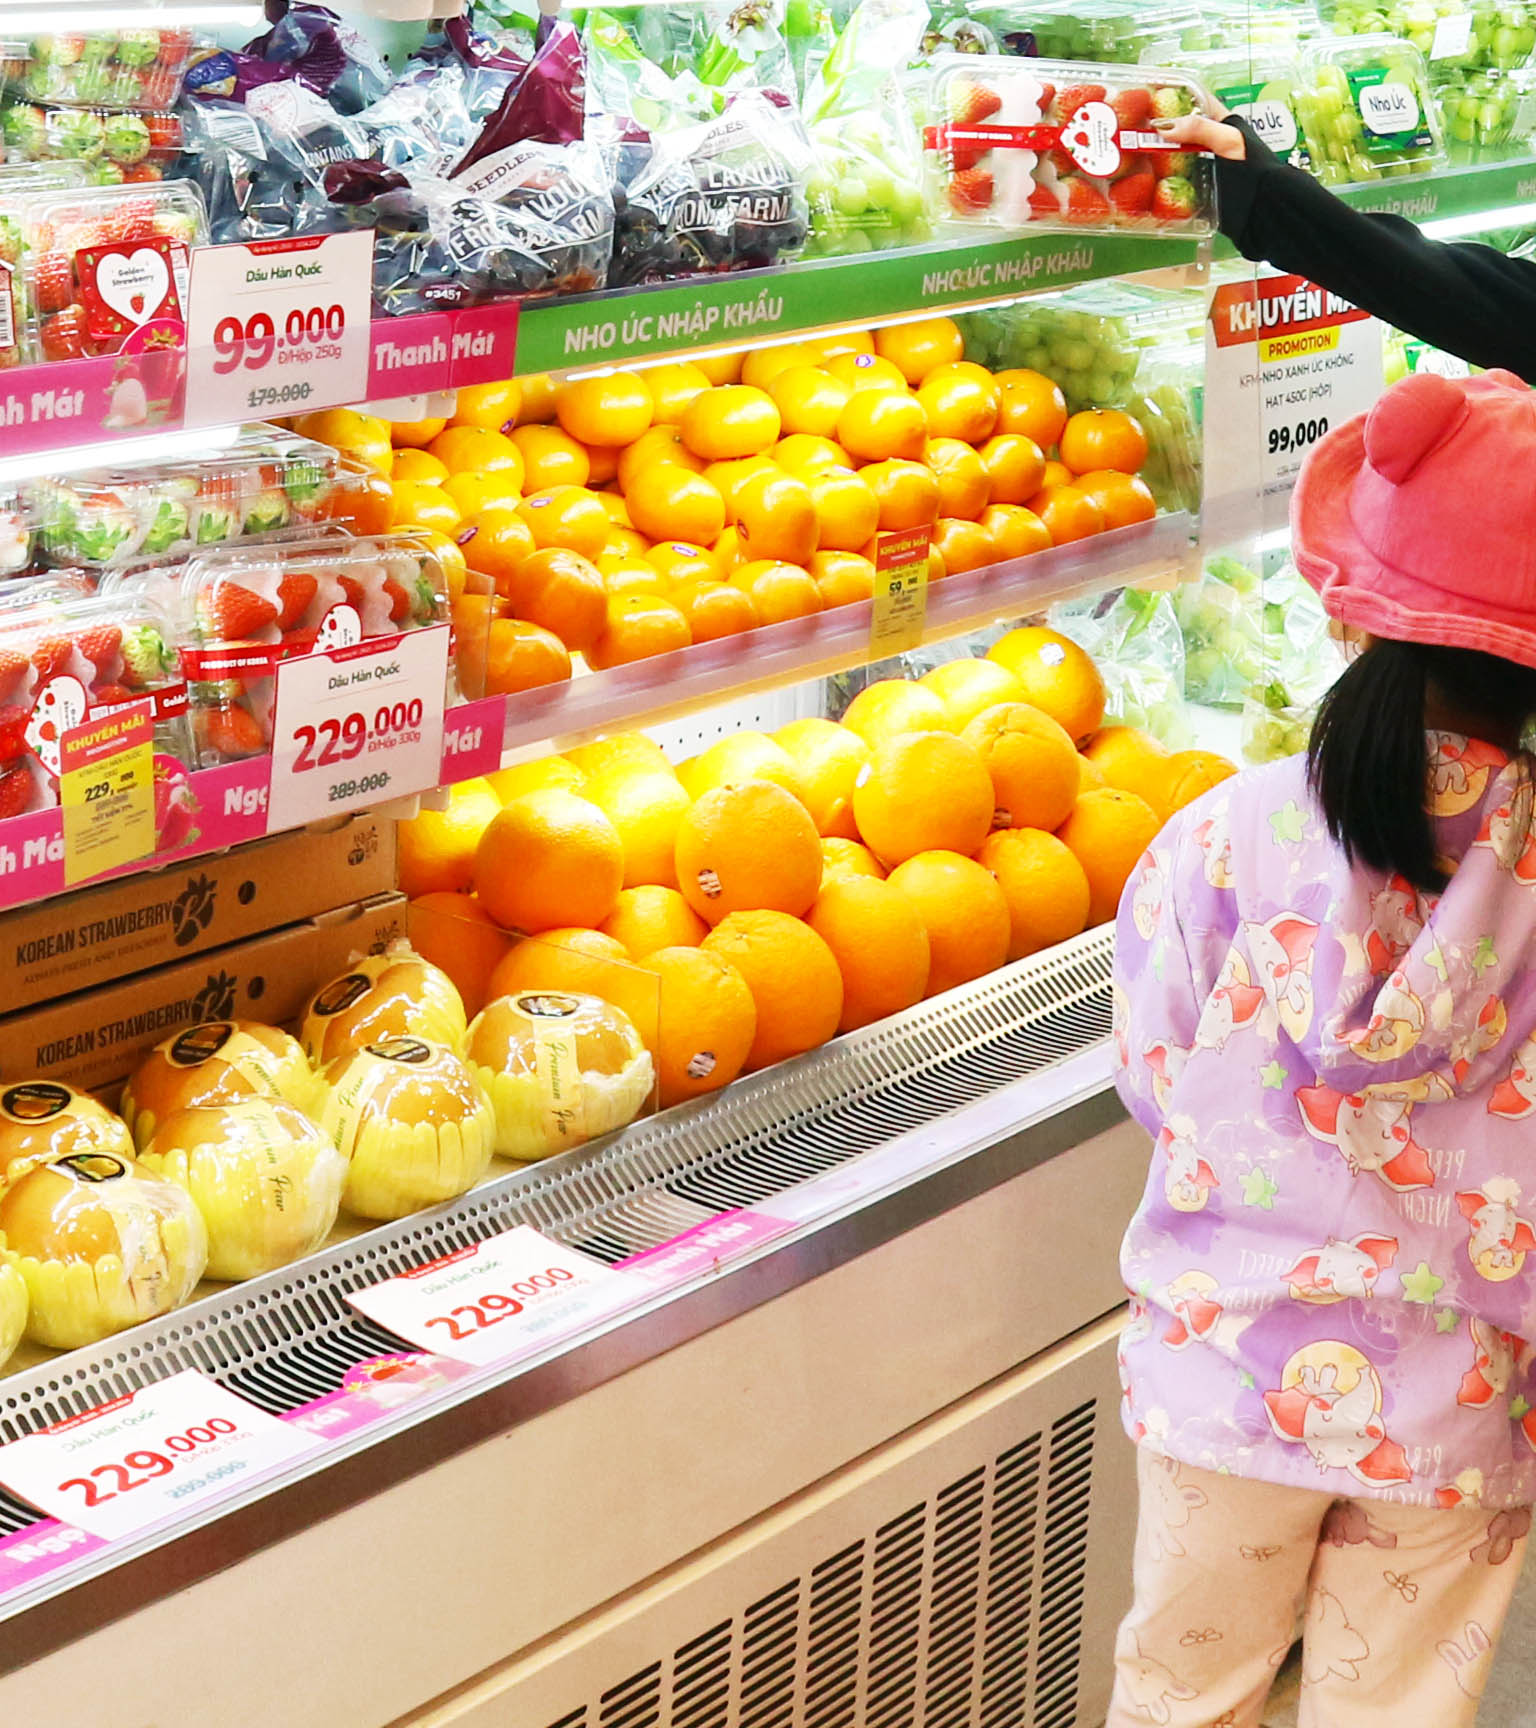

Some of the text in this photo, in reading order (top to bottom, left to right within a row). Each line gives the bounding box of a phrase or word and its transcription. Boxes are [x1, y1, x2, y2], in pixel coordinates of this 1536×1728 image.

[1265, 106, 1284, 130] Úc
[1368, 94, 1408, 112] Nho Úc
[111, 274, 155, 289] Strawberry
[118, 266, 147, 278] Golden
[246, 260, 322, 282] Dâu Hàn Quốc
[922, 248, 1094, 296] NHO ÚC NHẬP KHẨU
[213, 303, 345, 375] 99.000
[315, 344, 342, 359] 250g
[1268, 333, 1331, 357] PROMOTION
[1285, 363, 1310, 378] XANH
[1325, 353, 1354, 370] KHÔNG
[248, 382, 314, 407] 179.000
[328, 660, 401, 690] Dâu Hàn Quốc
[66, 713, 145, 753] KHUYẾN MÃI
[292, 698, 423, 774] 229.000
[328, 772, 391, 802] 289.000
[16, 900, 176, 968] KOREAN STRAWBERRY
[36, 997, 193, 1069] KOREAN STRAWBERRY
[268, 1175, 293, 1212] Pear
[424, 1266, 574, 1342] 229.000
[58, 1416, 238, 1508] 229.000
